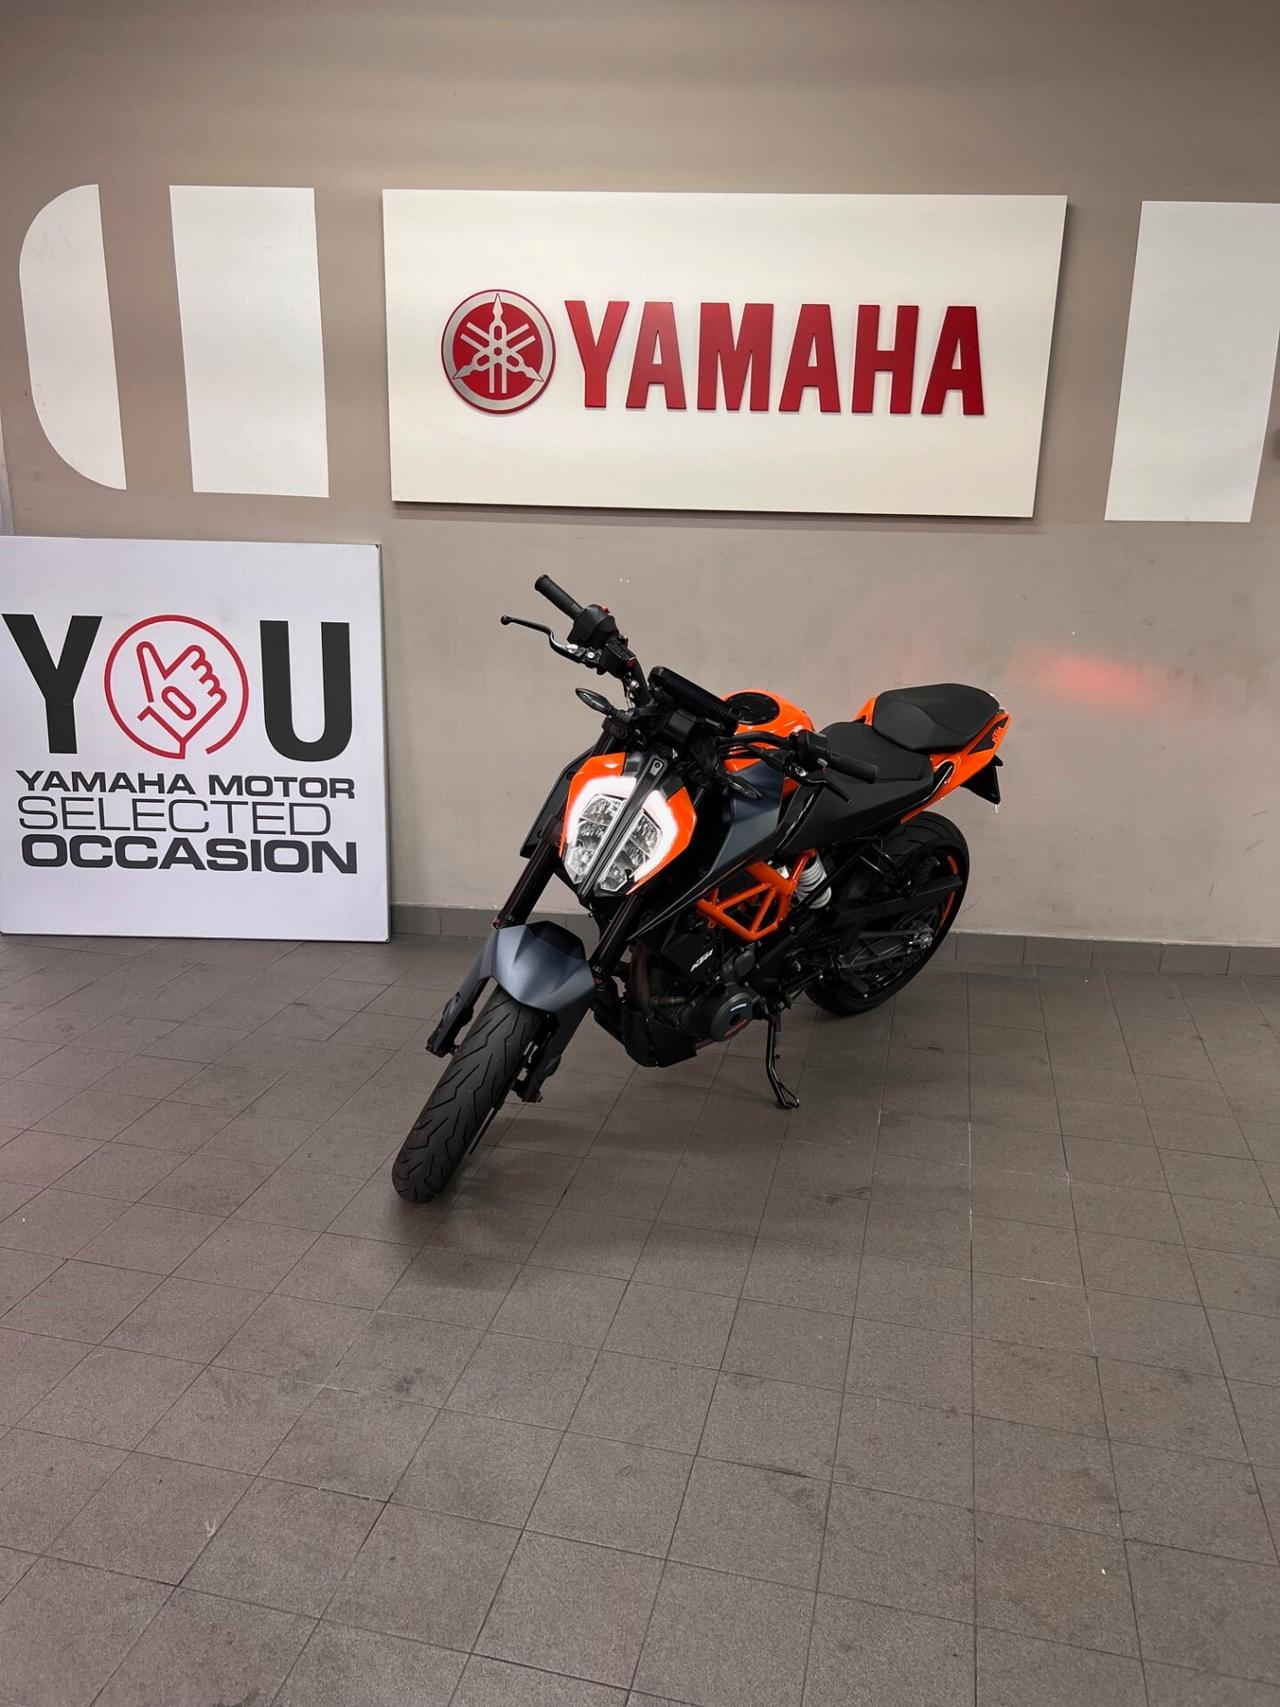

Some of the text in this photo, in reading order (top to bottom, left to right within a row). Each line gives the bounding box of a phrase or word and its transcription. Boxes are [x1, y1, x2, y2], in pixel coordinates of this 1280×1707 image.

[565, 299, 985, 416] YAMAHA
[15, 770, 355, 799] YAMAHA MOTOR
[18, 796, 332, 836] SELECTED
[21, 833, 358, 875] OCCASION
